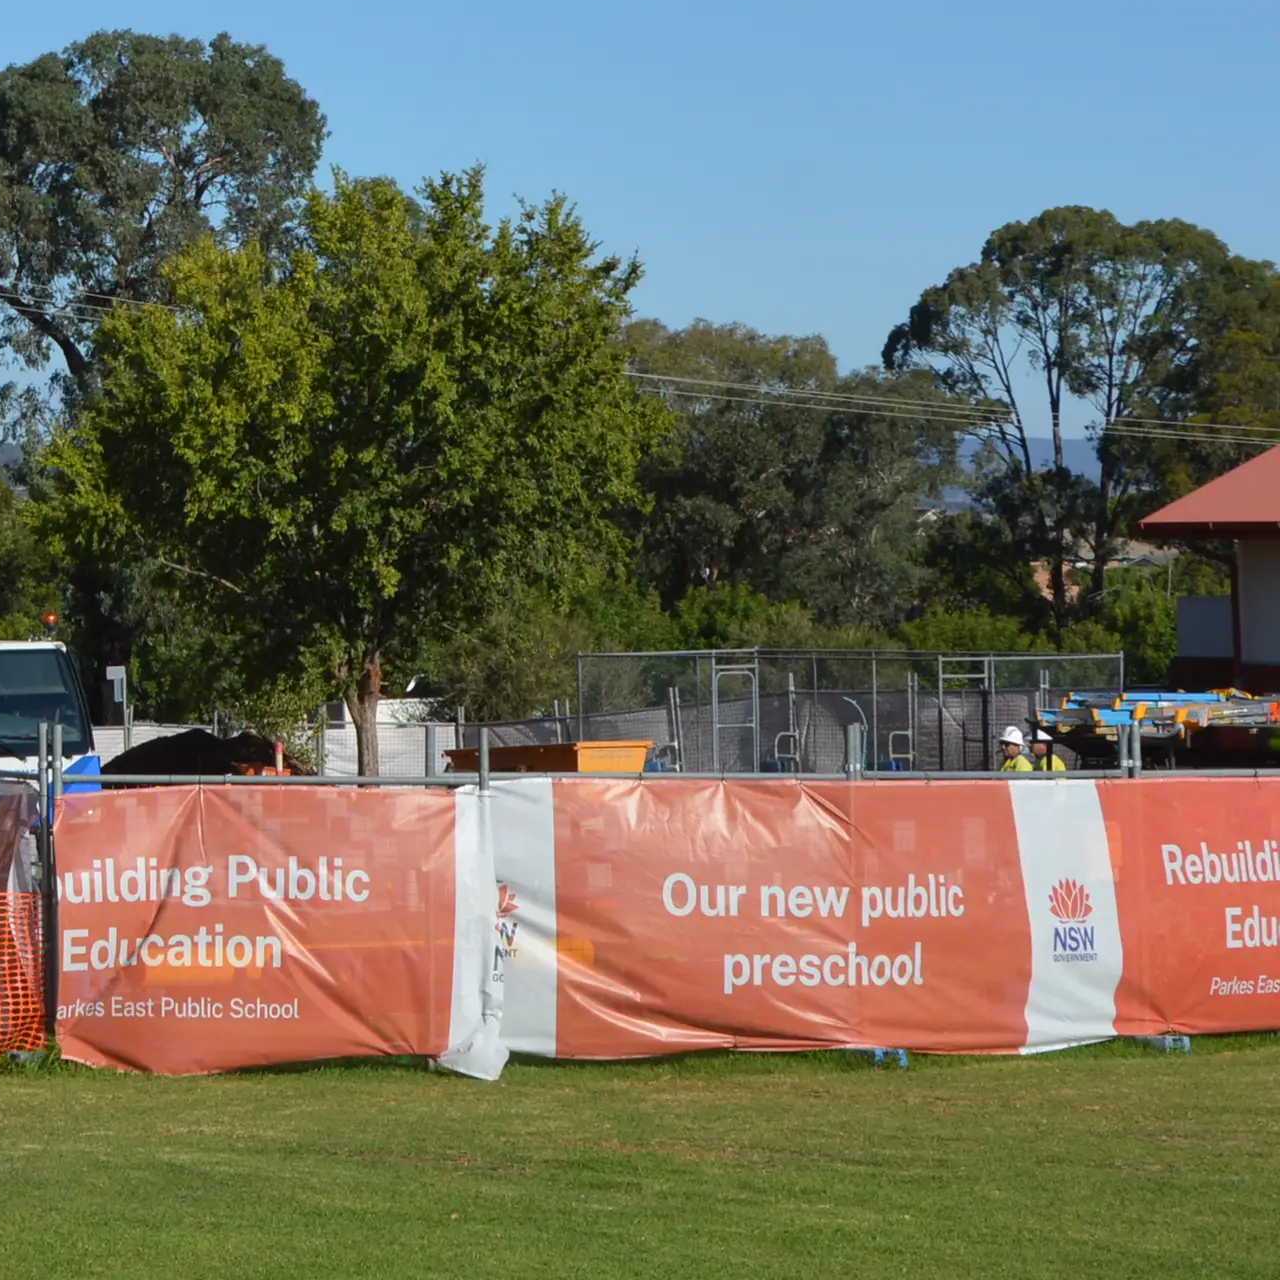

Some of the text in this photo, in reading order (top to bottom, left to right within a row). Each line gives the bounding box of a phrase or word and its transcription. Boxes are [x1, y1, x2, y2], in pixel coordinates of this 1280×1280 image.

[228, 855, 370, 901] Public
[662, 872, 965, 927] Our new public
[62, 923, 282, 972] Education
[1053, 925, 1095, 952] NSW
[723, 942, 923, 994] preschool
[1209, 975, 1280, 996] Parkes Eas
[56, 996, 300, 1020] arkes East Public School
